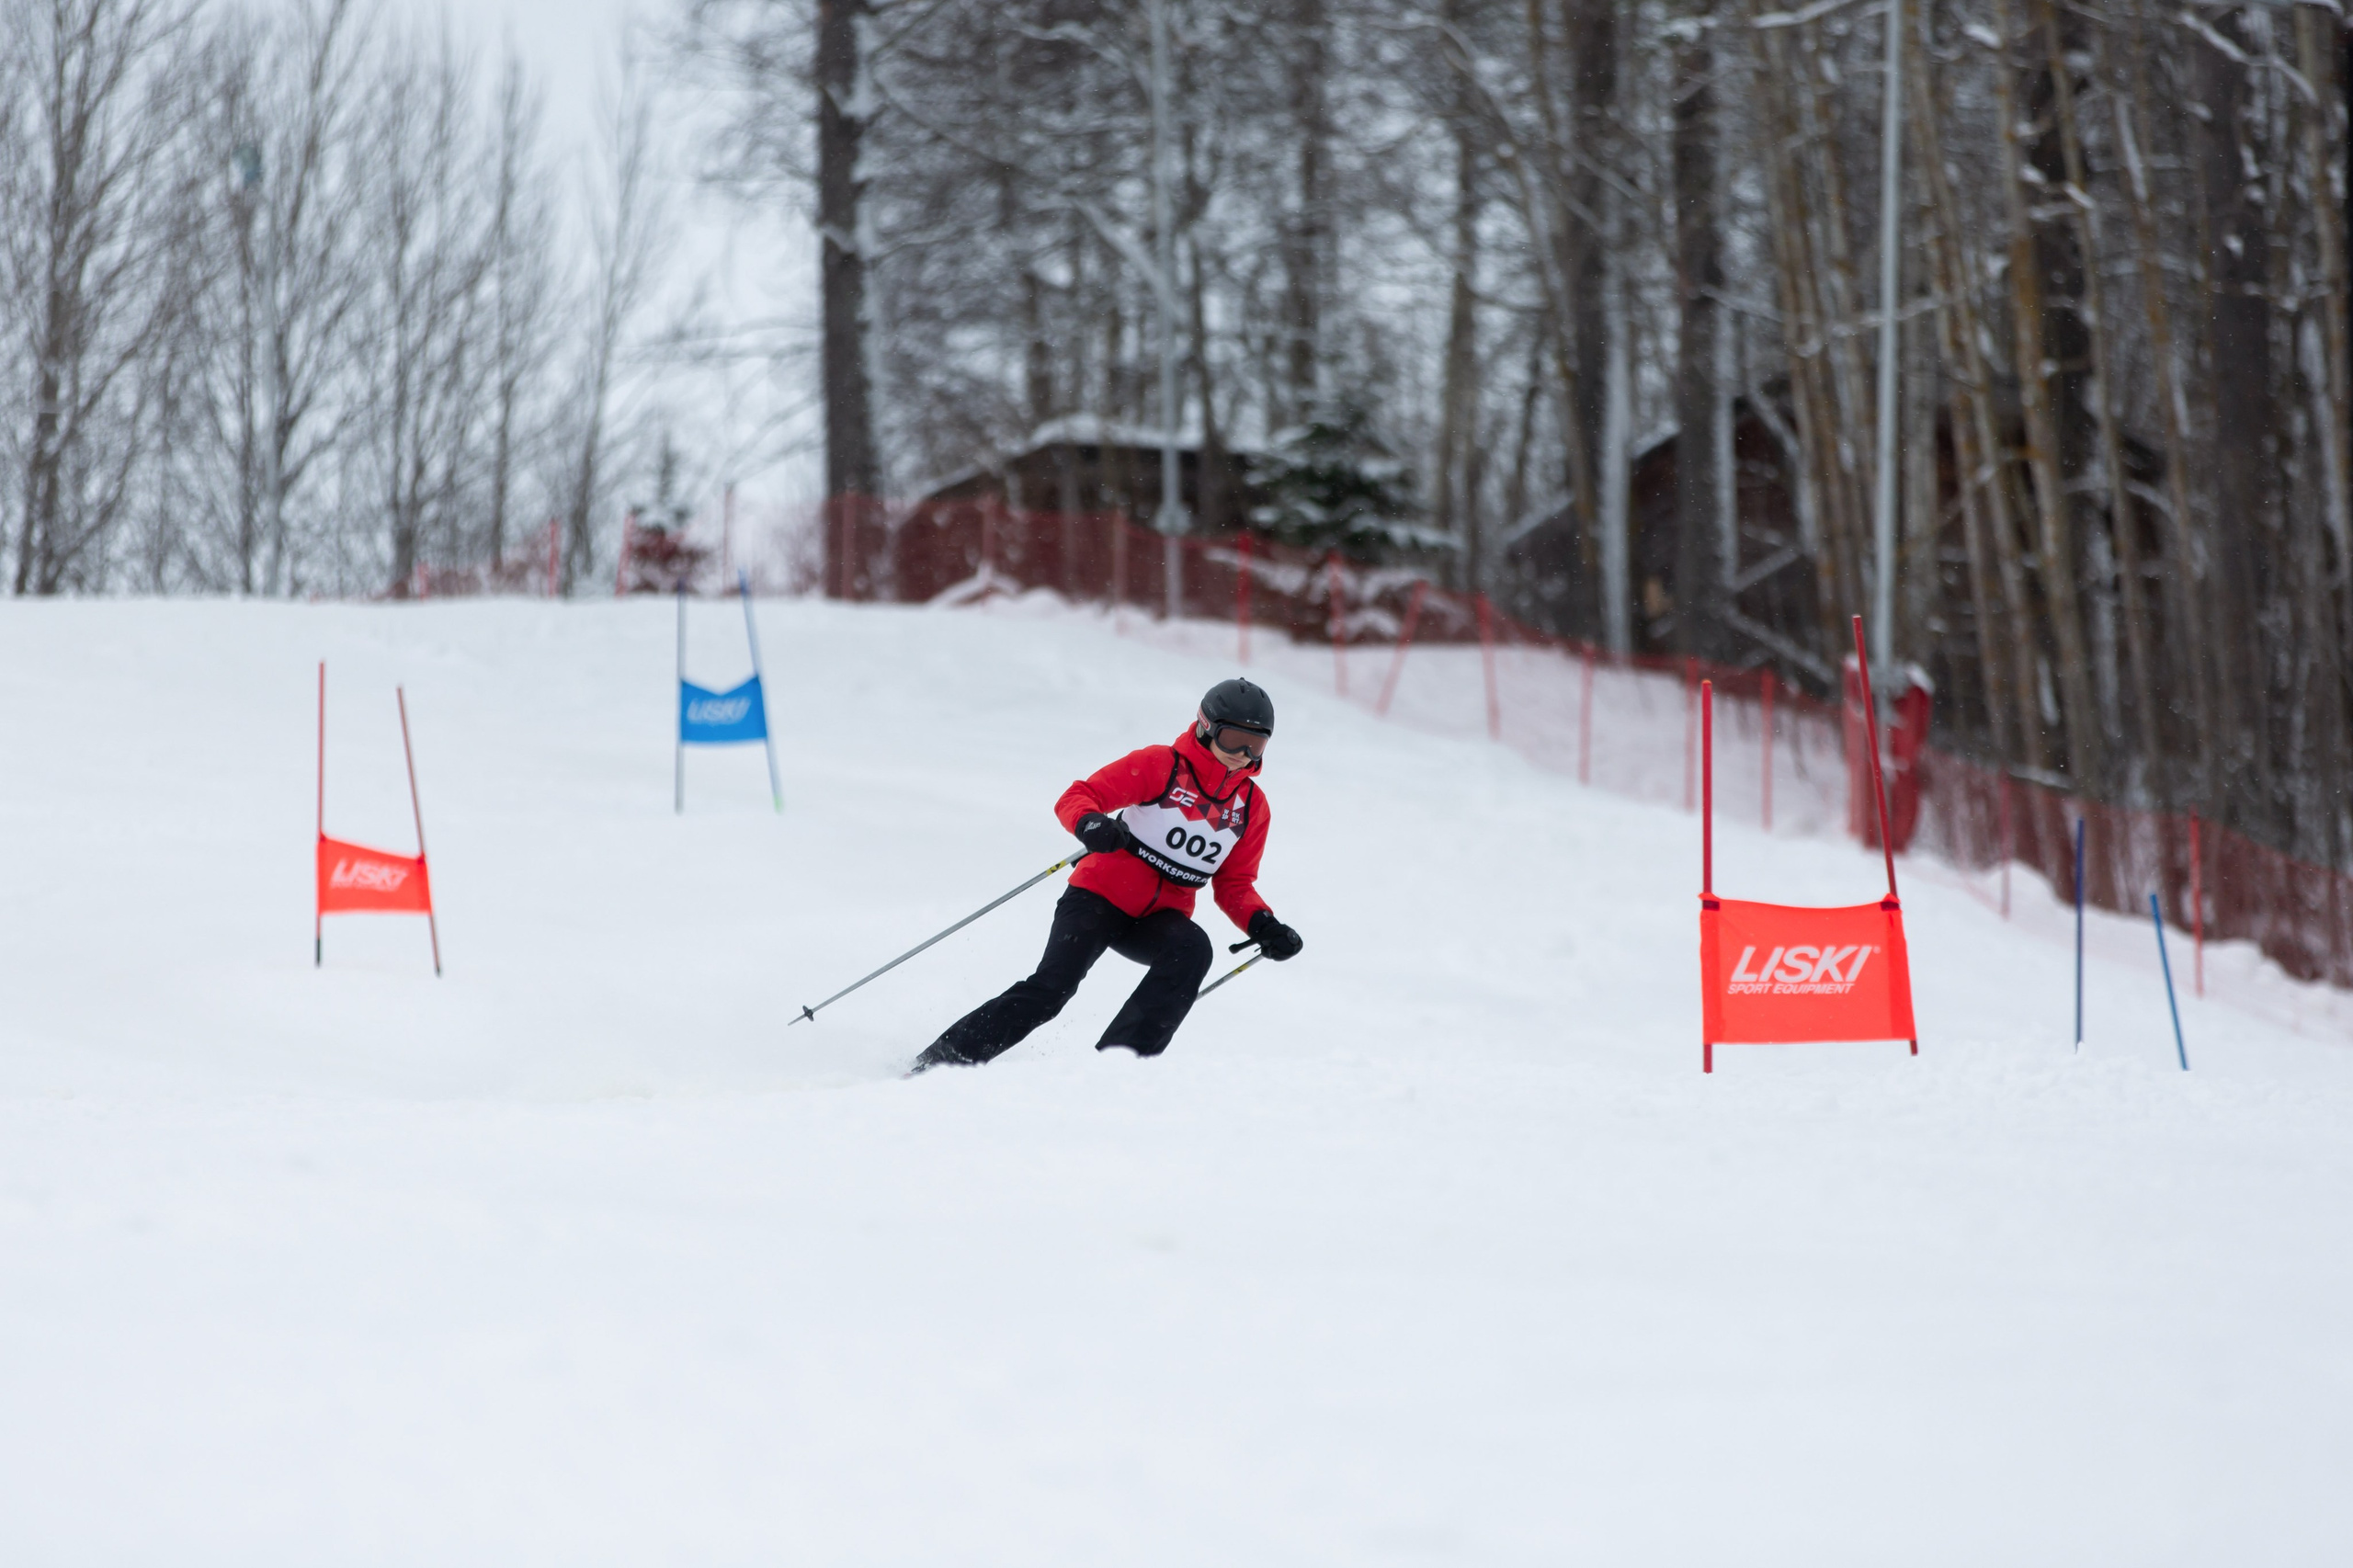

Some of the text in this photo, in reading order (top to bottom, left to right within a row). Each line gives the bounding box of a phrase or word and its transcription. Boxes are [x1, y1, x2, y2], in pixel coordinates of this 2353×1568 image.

[1165, 826, 1222, 865] 002
[1731, 945, 1872, 983] LISKI
[1727, 983, 1855, 994] SPORT EQUIPMENT
